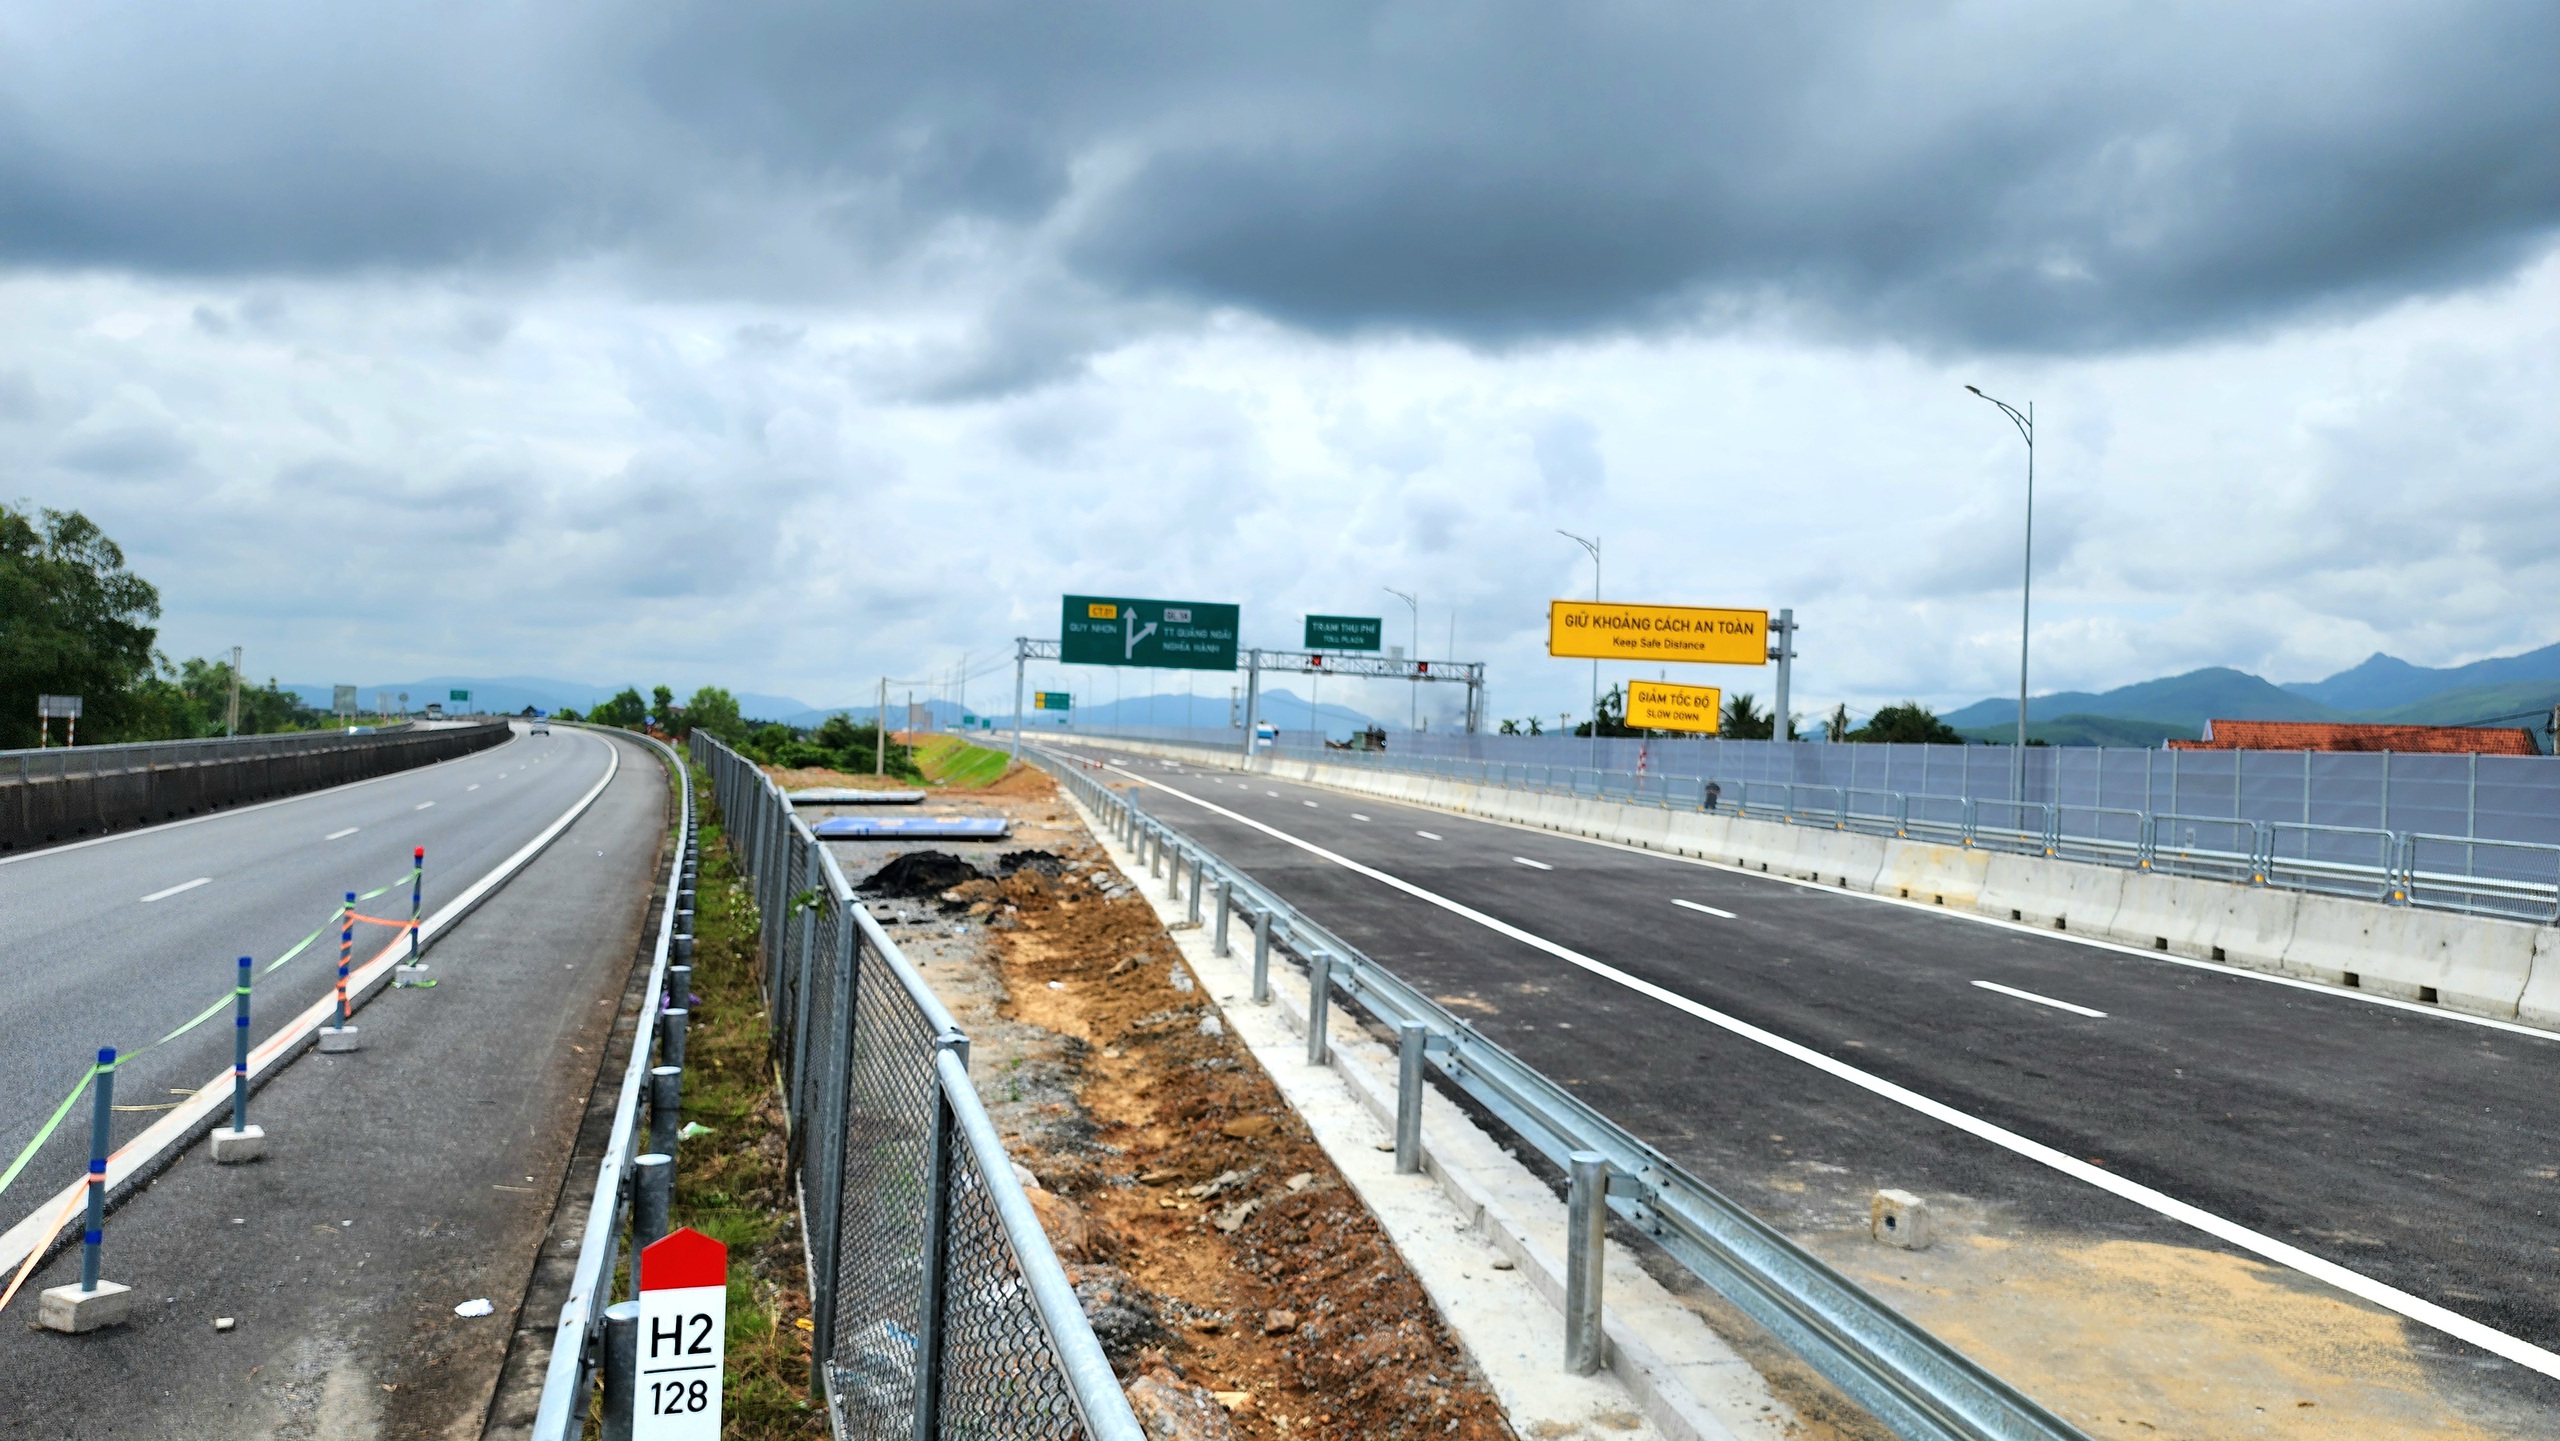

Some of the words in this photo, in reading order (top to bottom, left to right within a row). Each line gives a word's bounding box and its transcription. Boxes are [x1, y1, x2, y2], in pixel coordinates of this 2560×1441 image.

[1565, 610, 1589, 628] GIỮ
[1592, 612, 1651, 631] KHOẢNG
[1654, 615, 1690, 632] CÁCH
[1694, 620, 1714, 633] AN
[1718, 617, 1754, 635] TOÀN
[1613, 637, 1637, 649] Keep
[1640, 637, 1661, 648] Safe
[1664, 639, 1705, 650] Distance
[1638, 688, 1666, 704] GIẢM
[1670, 690, 1691, 707] TỐC
[1694, 695, 1710, 710] ĐỘ
[1647, 709, 1671, 719] SLOW
[1673, 712, 1699, 722] DOWN
[651, 1313, 713, 1358] H2
[651, 1379, 708, 1415] 128
